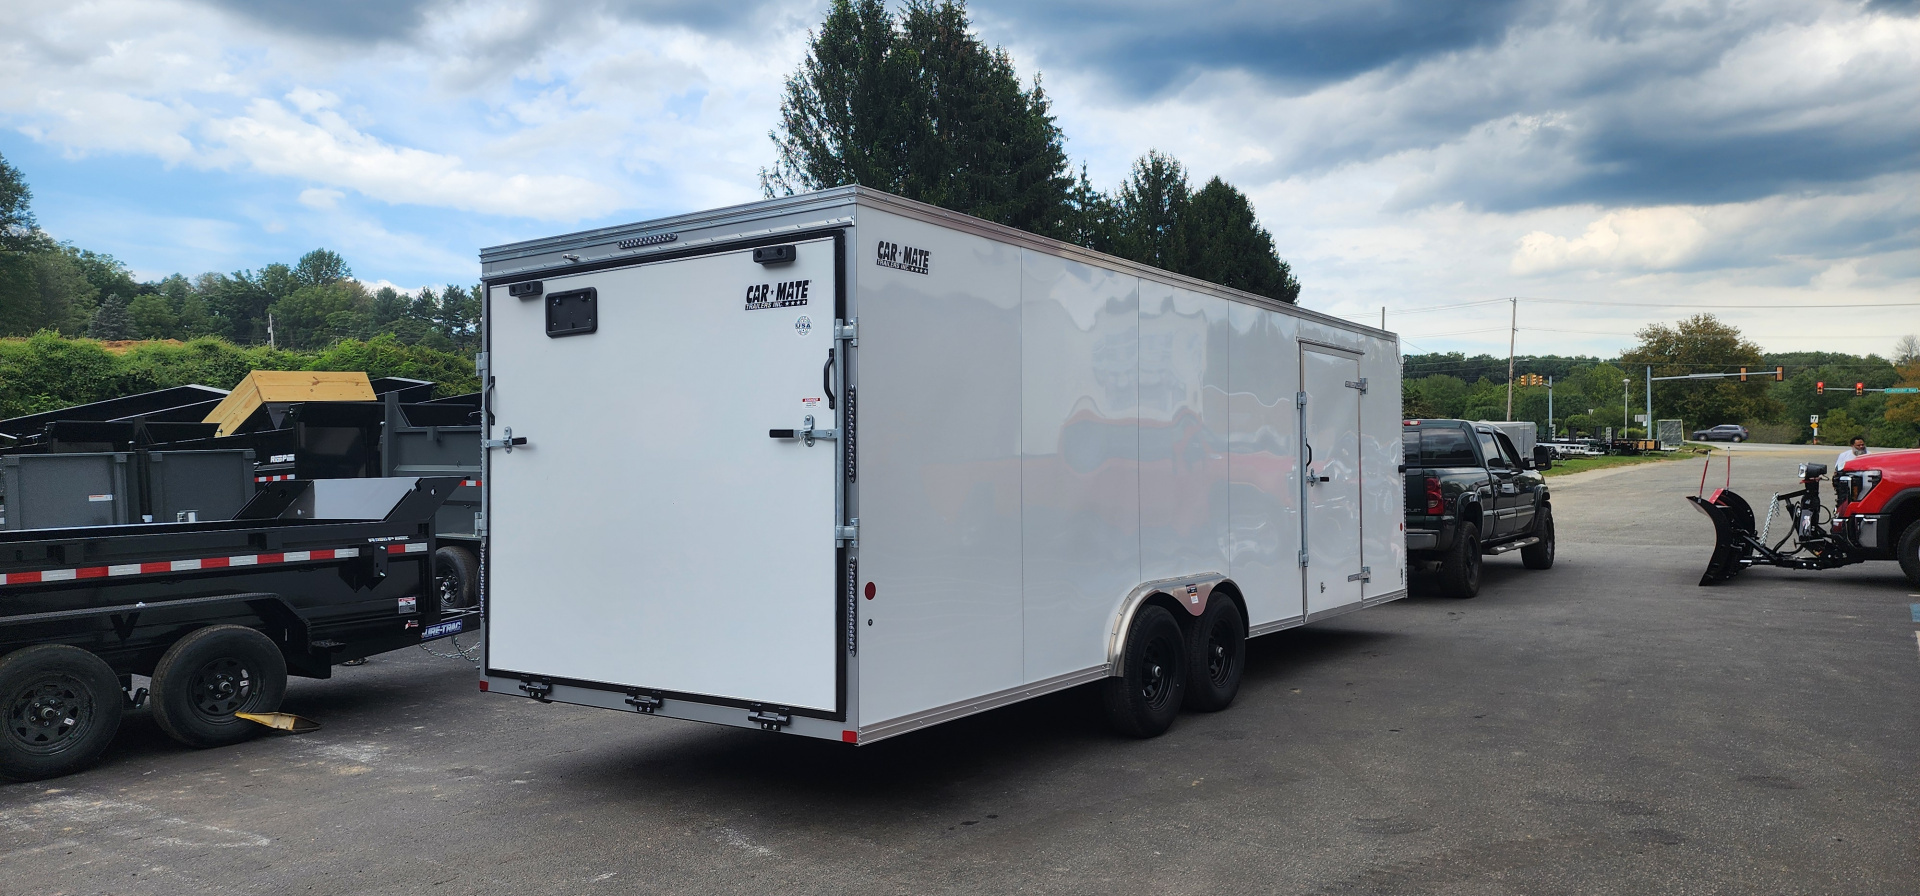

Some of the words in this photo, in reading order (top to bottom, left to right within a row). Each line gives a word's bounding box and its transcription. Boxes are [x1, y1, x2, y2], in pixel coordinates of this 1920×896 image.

[878, 240, 898, 261] CAR
[903, 245, 930, 268] MATE
[746, 284, 770, 304] CAR
[776, 279, 810, 301] MATE
[421, 621, 462, 638] URE-TRAC
